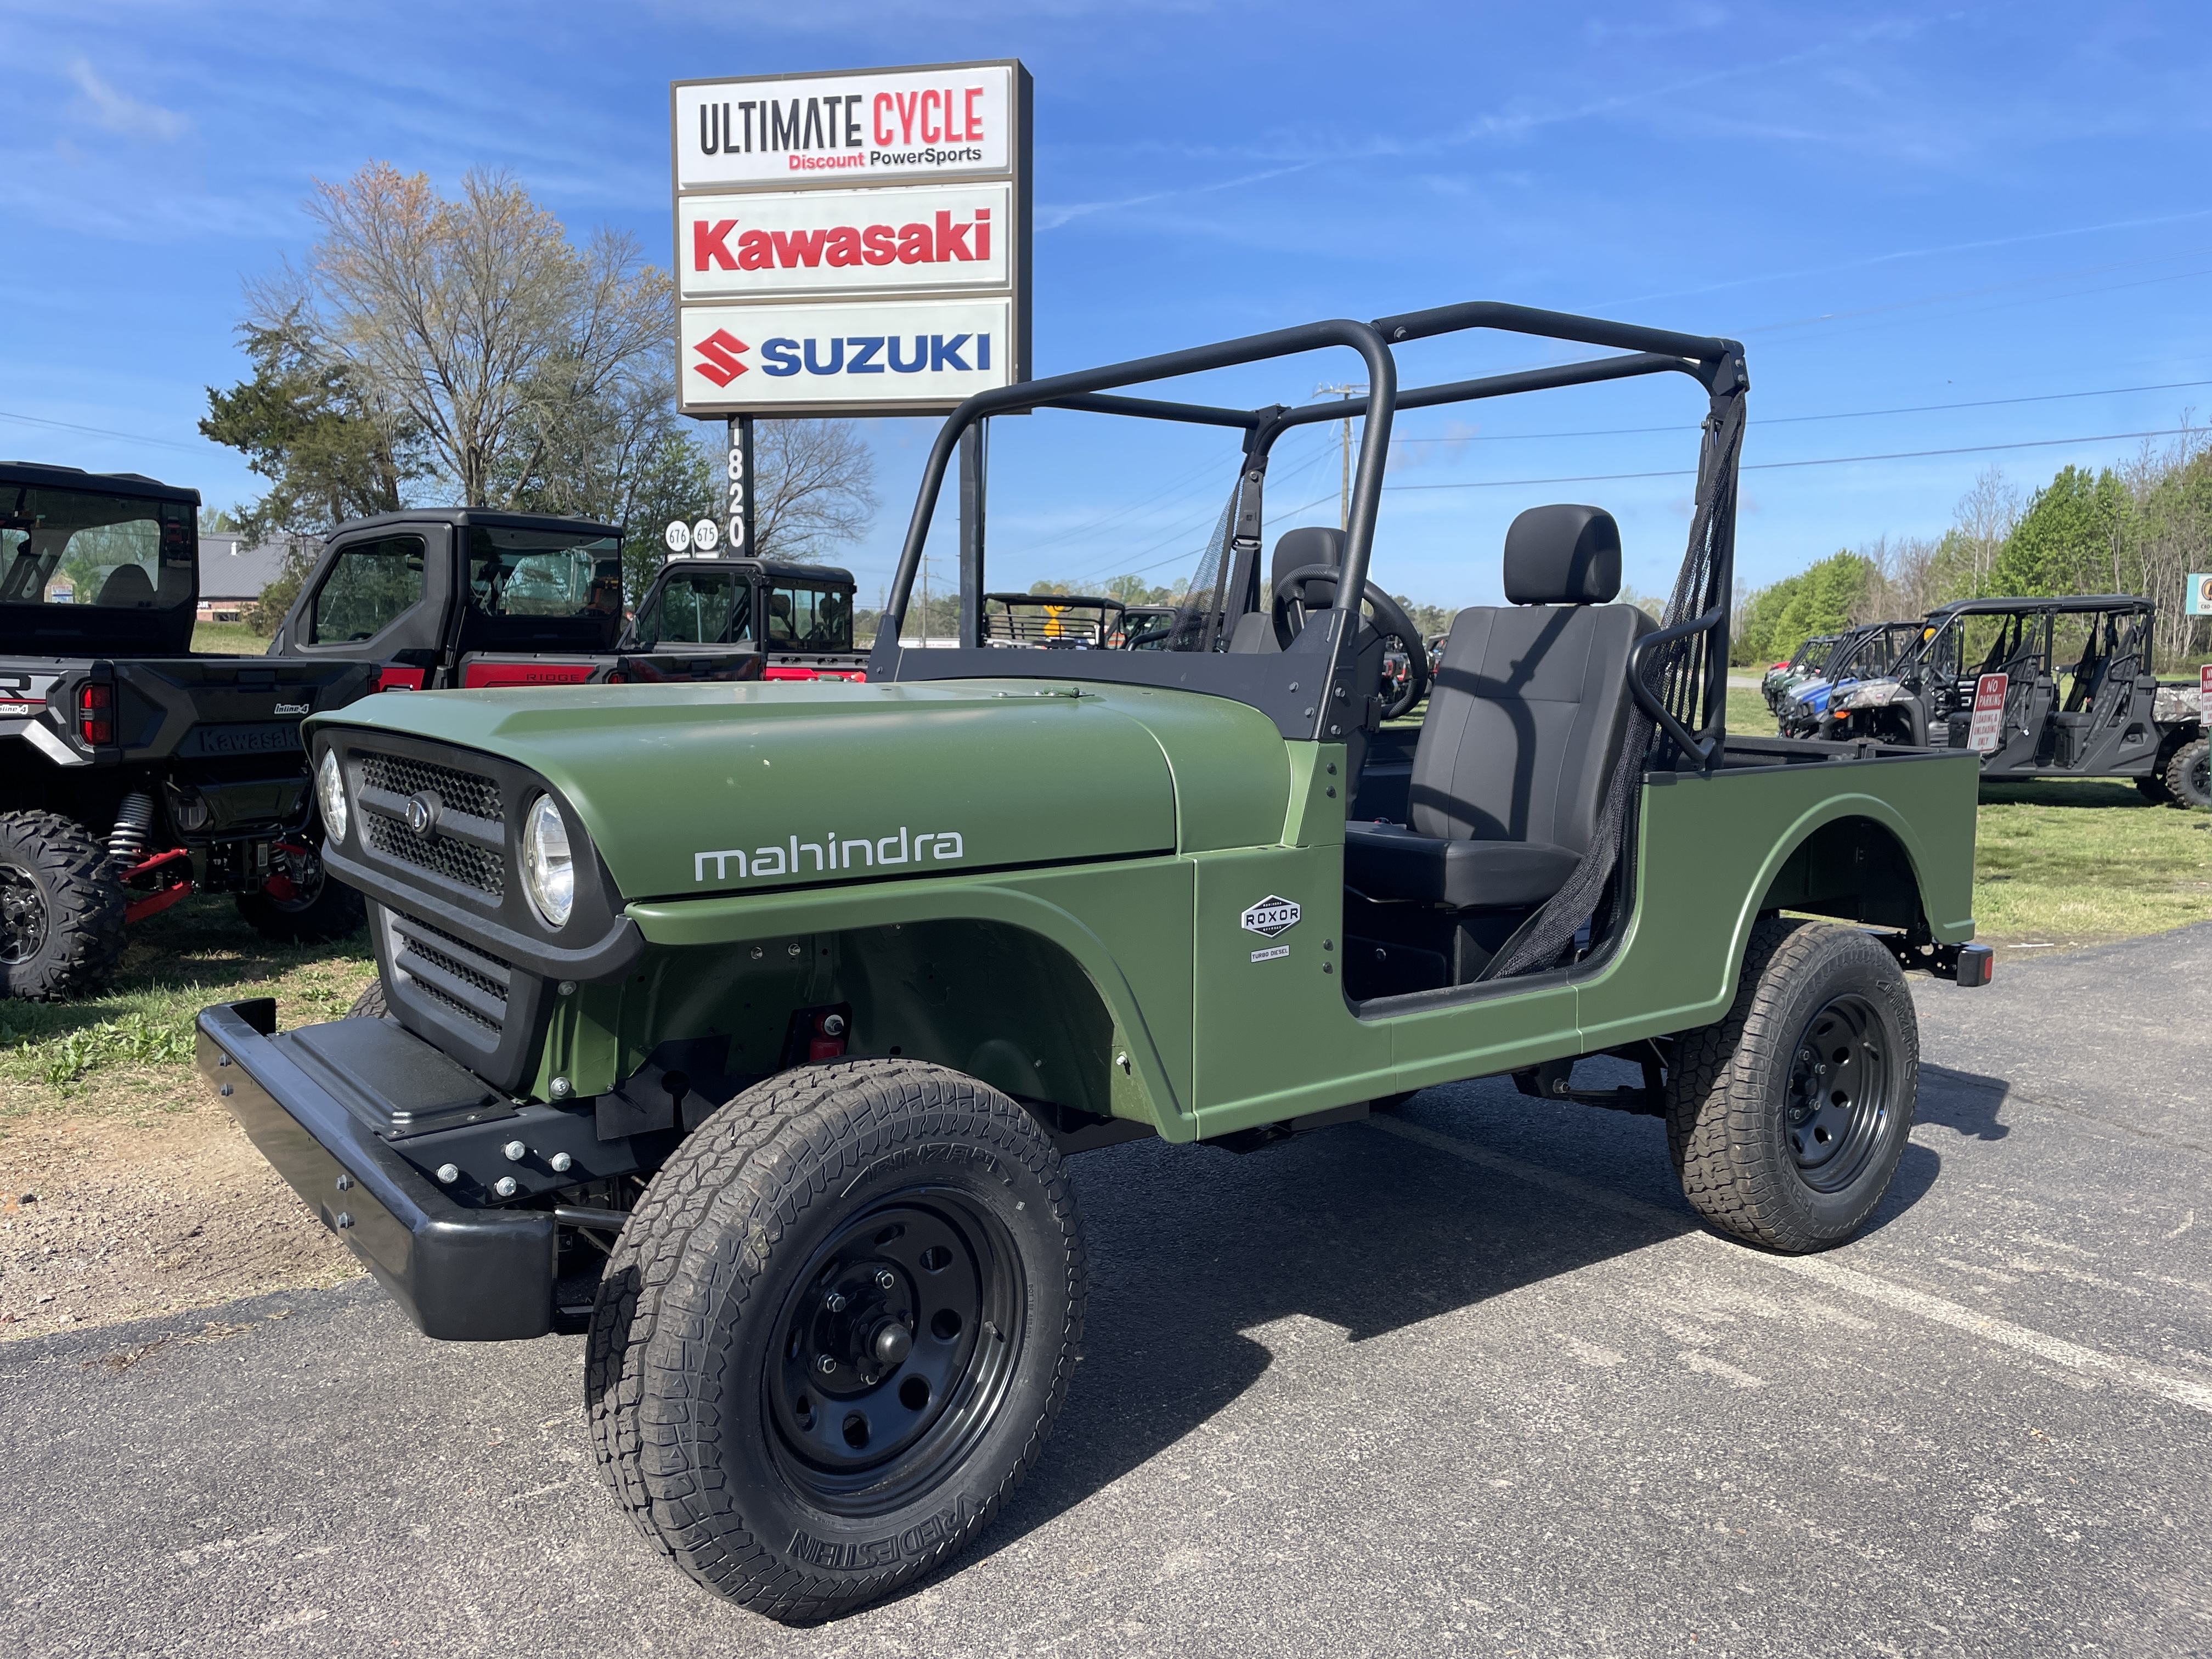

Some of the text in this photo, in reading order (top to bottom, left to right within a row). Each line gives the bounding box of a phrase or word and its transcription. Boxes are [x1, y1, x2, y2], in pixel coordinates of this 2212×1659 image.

[699, 85, 984, 155] ULTIMATE CYCLE
[788, 145, 982, 171] Discount PowerSports
[693, 207, 991, 271] Kawasaki
[760, 332, 990, 376] SUZUKI
[728, 416, 744, 548] 1820
[669, 528, 686, 543] 676
[697, 527, 714, 541] 675
[1978, 693, 2002, 708] PARKING
[1987, 679, 1999, 693] NO
[695, 827, 963, 881] mahindra
[1246, 907, 1299, 926] ROXOR
[786, 1491, 985, 1568] VREDESTEIN
